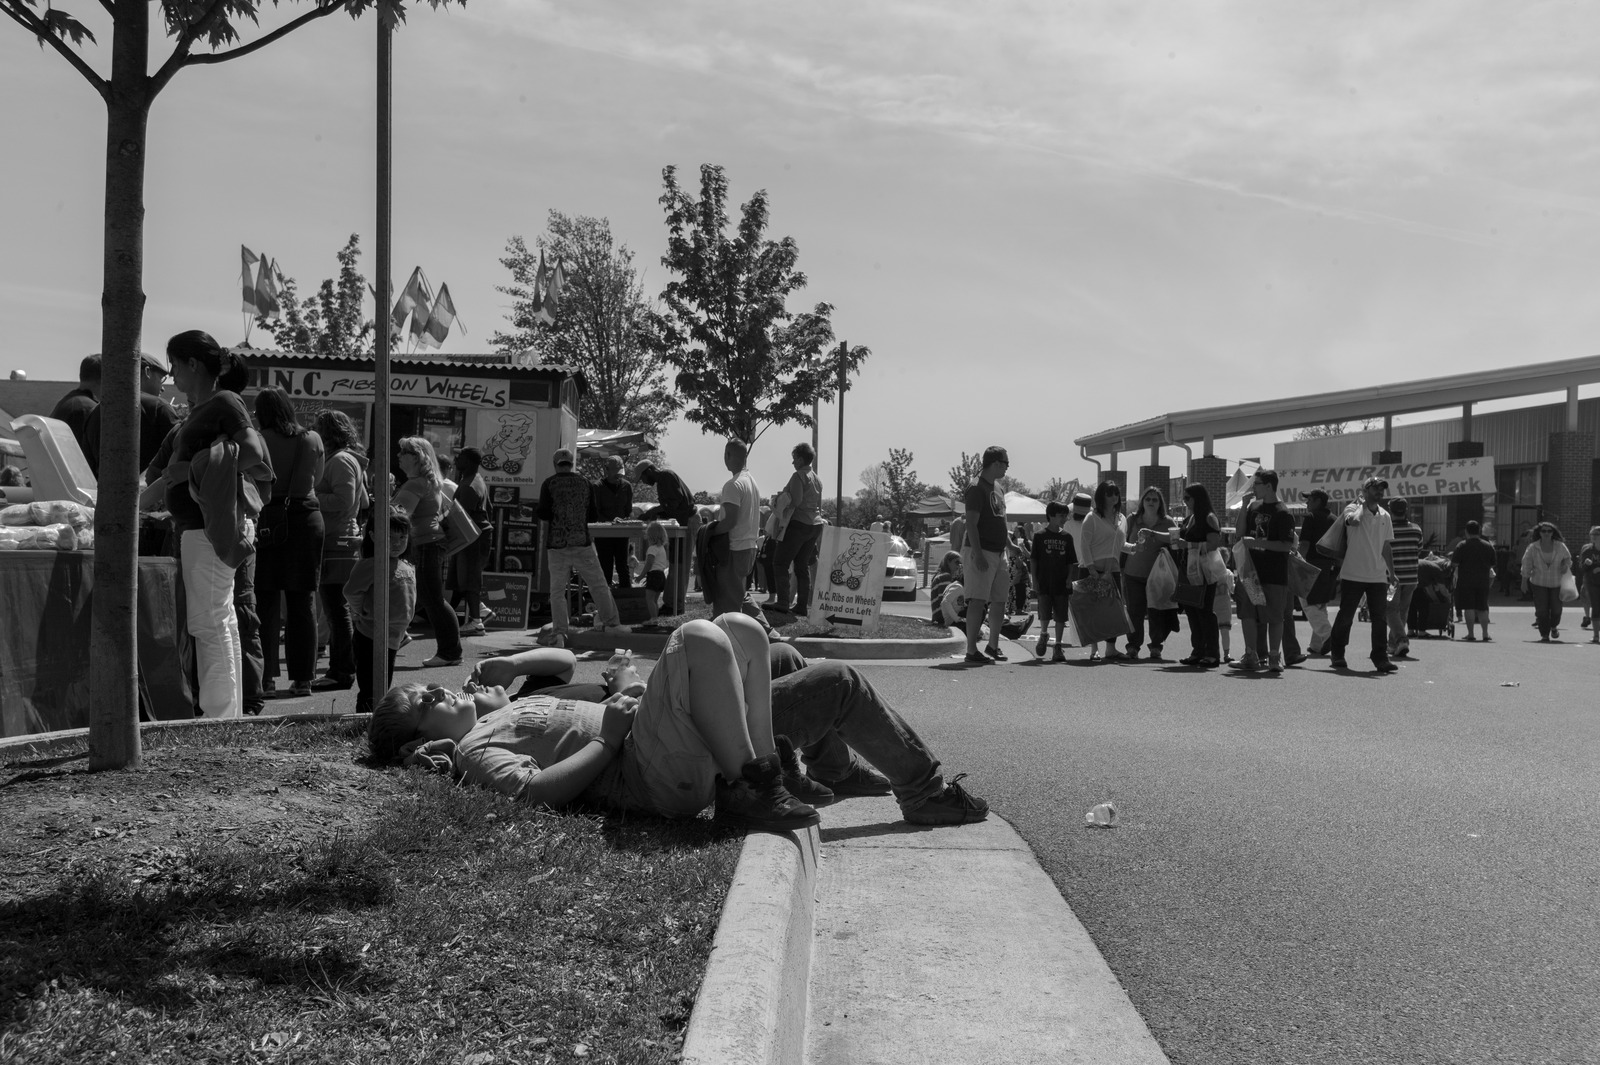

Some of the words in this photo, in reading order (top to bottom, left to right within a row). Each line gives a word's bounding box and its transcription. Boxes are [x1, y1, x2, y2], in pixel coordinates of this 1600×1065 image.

[274, 370, 329, 396] N.C.
[390, 378, 418, 391] ON
[425, 376, 506, 407] WHEELS
[1311, 462, 1444, 483] ENTRANCE
[1396, 480, 1429, 496] the
[1435, 476, 1482, 494] Park
[505, 582, 526, 590] Welcome
[831, 592, 845, 602] Ribs
[855, 594, 876, 606] Wheels
[819, 603, 843, 612] Ahead
[856, 606, 872, 616] Left
